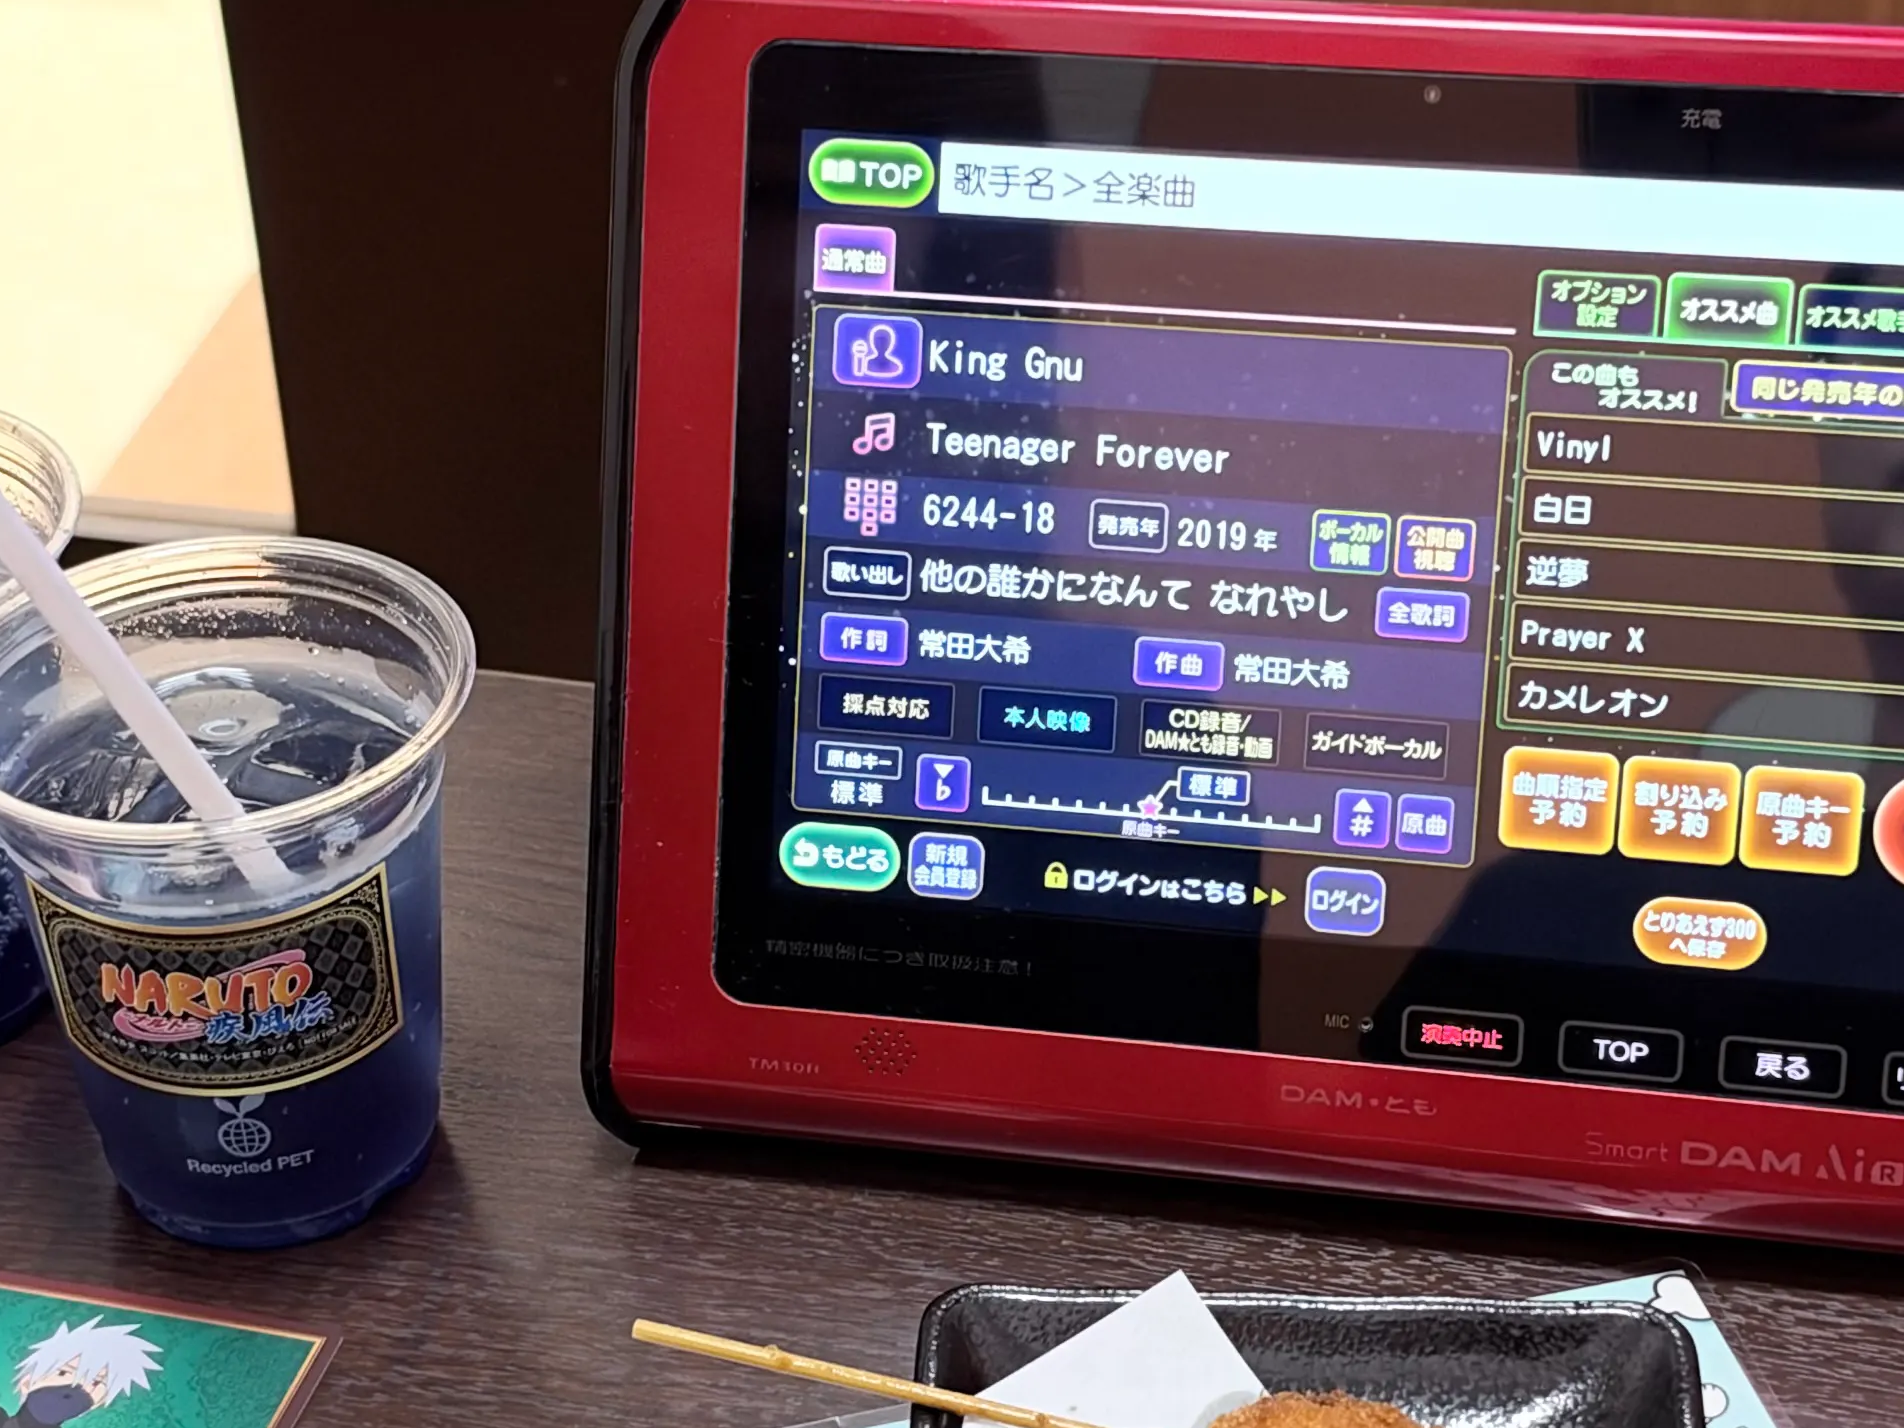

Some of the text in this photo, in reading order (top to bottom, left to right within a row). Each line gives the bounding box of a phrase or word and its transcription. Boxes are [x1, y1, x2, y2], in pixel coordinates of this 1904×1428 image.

[1681, 109, 1723, 130] 充電
[859, 159, 924, 190] TOP
[821, 248, 887, 275] 通常曲
[1550, 280, 1648, 306] オプション
[1576, 303, 1617, 328] 設定
[1679, 297, 1778, 326] オススメ曲
[927, 347, 1084, 383] King Gnu
[1550, 362, 1639, 387] この曲も
[1598, 388, 1698, 413] オススメ!
[926, 422, 1230, 475] Teenager Forever
[1536, 429, 1612, 466] Vinyl
[922, 493, 1056, 536] 6244-18
[1533, 493, 1593, 527] 白日
[1097, 512, 1161, 539] 発売年
[1318, 519, 1385, 546] ボーカル
[1406, 523, 1465, 552] 公開曲
[1327, 540, 1372, 569] 情報
[1413, 547, 1456, 573] 視聴
[831, 560, 905, 588] 歌い出し
[1526, 556, 1590, 588] 逆夢
[920, 557, 1349, 625] 他の誰かになんて なれやし
[1388, 600, 1457, 629] 全歌詞
[840, 627, 1032, 666] 作詞 常田大希
[1520, 618, 1646, 655] Prayer X
[1154, 651, 1351, 691] 作曲 常田大希
[842, 692, 931, 722] 採点対応
[1517, 681, 1670, 719] カメレオン
[1003, 705, 1092, 735] 本人映像
[826, 749, 893, 772] 原曲キー
[1312, 730, 1443, 762] ガイドボーカル
[830, 780, 885, 808] 標準
[1188, 773, 1238, 801] 標準
[1512, 772, 1608, 804] 曲順指定
[1634, 781, 1728, 814] 割り込み
[1529, 800, 1587, 829] 予約
[1755, 791, 1852, 821] 原曲キー
[1121, 820, 1181, 841] 原曲キー
[1400, 811, 1448, 838] 原曲
[1650, 811, 1709, 840] 予約
[1772, 820, 1832, 851] 予約
[822, 842, 890, 872] もどる
[925, 842, 968, 867] 新規
[914, 866, 978, 891] 会員登録
[1073, 869, 1247, 906] ログインはこちら
[1311, 887, 1380, 916] ログイン
[100, 960, 313, 1019] NARUTO
[204, 991, 336, 1045] 疾風伝
[1324, 1013, 1351, 1030] MIC
[1421, 1022, 1503, 1052] 演奏中止
[1593, 1037, 1650, 1064] TOP
[1755, 1051, 1812, 1081] 戻る
[186, 1149, 316, 1179] Recycled PET
[1584, 1131, 1669, 1163] Smart
[1680, 1140, 1802, 1177] DAM
